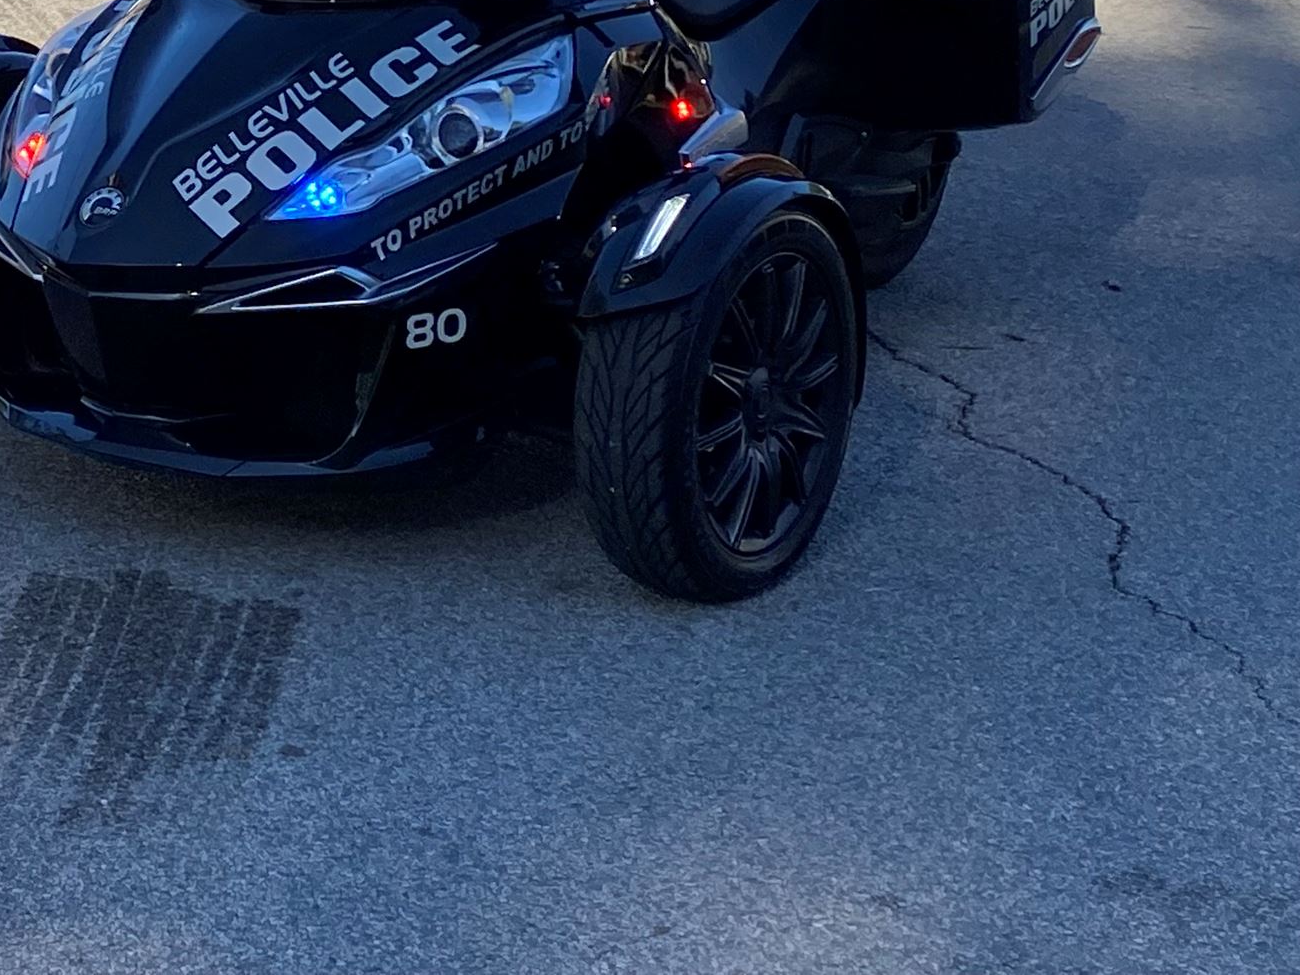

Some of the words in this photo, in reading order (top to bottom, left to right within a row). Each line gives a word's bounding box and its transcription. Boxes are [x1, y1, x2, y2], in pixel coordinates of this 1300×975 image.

[172, 52, 354, 202] BELLEVILLE
[188, 20, 482, 239] POLICE
[370, 228, 402, 261] TO
[409, 164, 508, 239] PROTECT
[512, 139, 554, 178] AND
[560, 124, 583, 150] TO
[406, 308, 467, 350] 80
